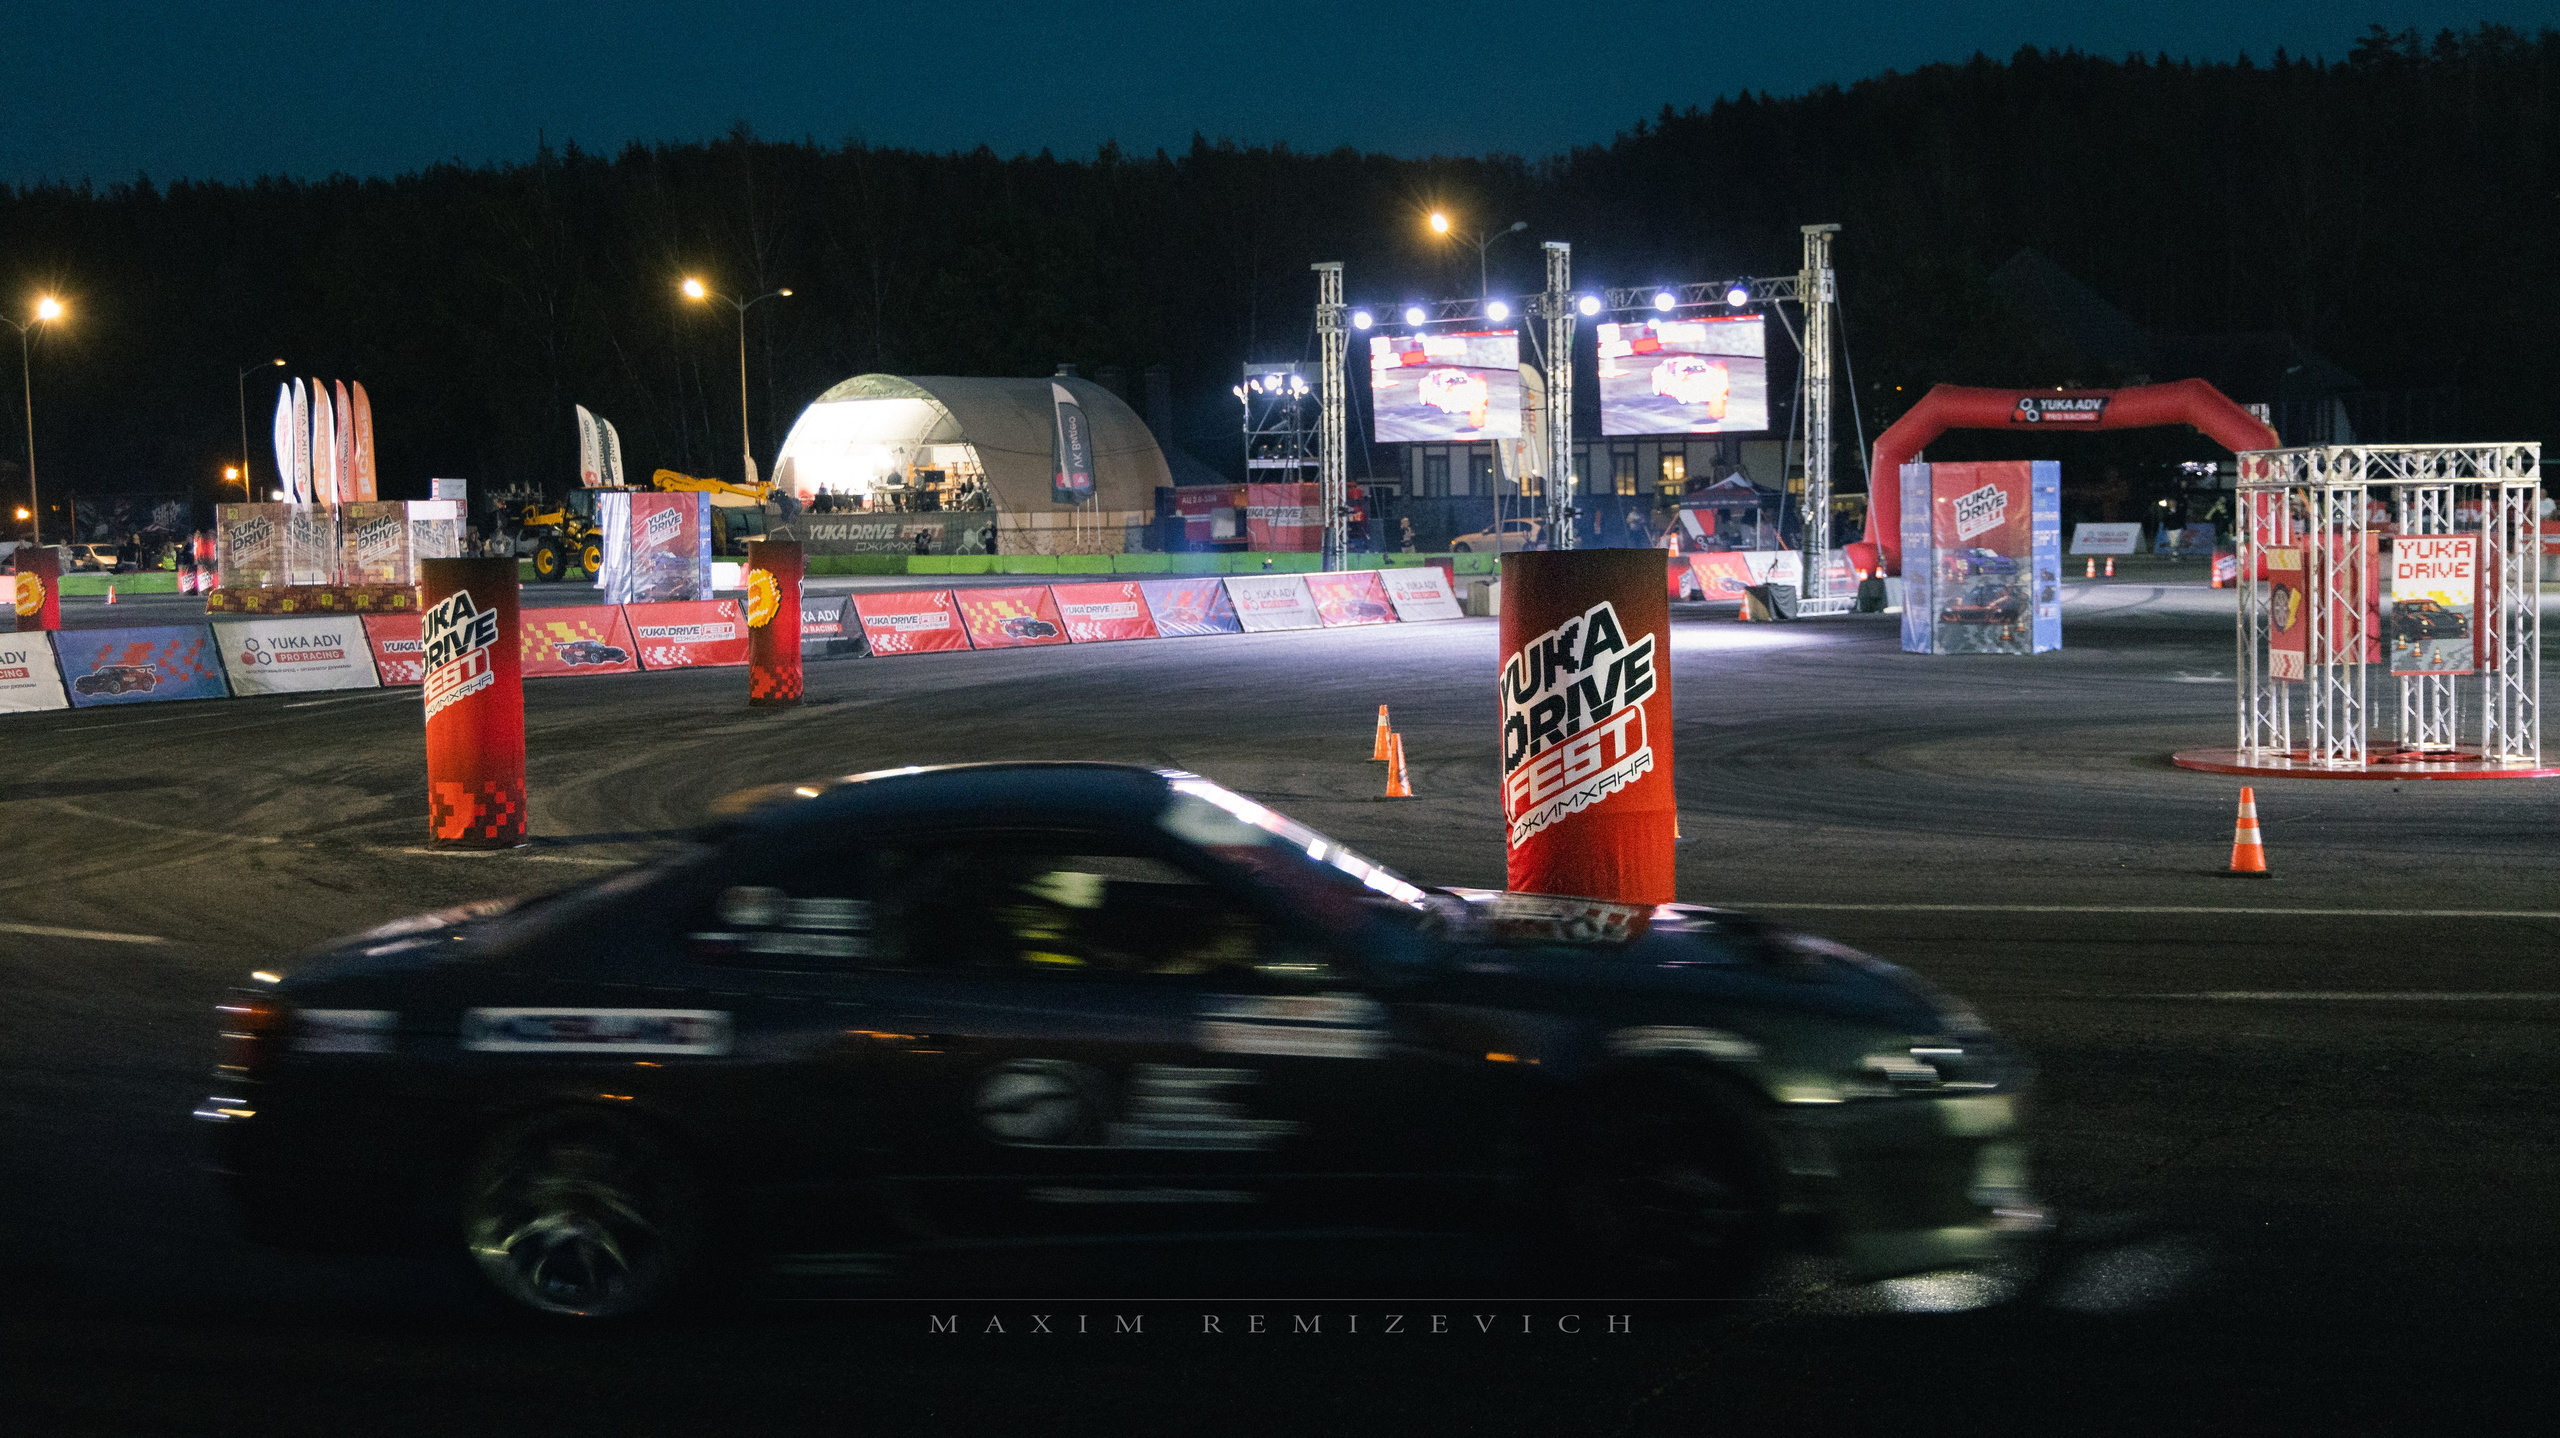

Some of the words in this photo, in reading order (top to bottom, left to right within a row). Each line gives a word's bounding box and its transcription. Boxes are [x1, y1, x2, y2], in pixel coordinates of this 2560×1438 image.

[2040, 399, 2074, 410] YUKA
[2075, 399, 2102, 410] ADV
[1955, 486, 1996, 510] YUKA
[648, 508, 675, 526] YUKA
[1959, 494, 2005, 523] DRIVE
[230, 515, 265, 539] YUKA
[355, 514, 392, 537] YUKA
[650, 514, 681, 534] DRIVE
[809, 524, 848, 540] YUKA
[849, 523, 897, 540] DRIVE
[232, 524, 274, 551] DRIVE
[358, 523, 401, 551] DRIVE
[2398, 541, 2471, 559] YUKA
[2398, 562, 2470, 579] DRIVE
[818, 610, 839, 621] ADV
[1086, 605, 1110, 613] DRIVE
[810, 624, 838, 632] RACING
[865, 617, 889, 625] YUKA
[890, 616, 918, 624] DRIVE
[640, 627, 666, 636] YUKA
[668, 626, 700, 635] DRIVE
[268, 636, 310, 650] YUKA
[313, 634, 342, 647] ADV
[384, 641, 415, 651] YUKA
[280, 653, 300, 662] PRO
[302, 651, 340, 661] RACING
[1500, 607, 1625, 720] YUKA
[1505, 638, 1653, 778] DRIVE
[1509, 707, 1636, 820] FEST
[1513, 753, 1650, 844] ДЖИМХАНА
